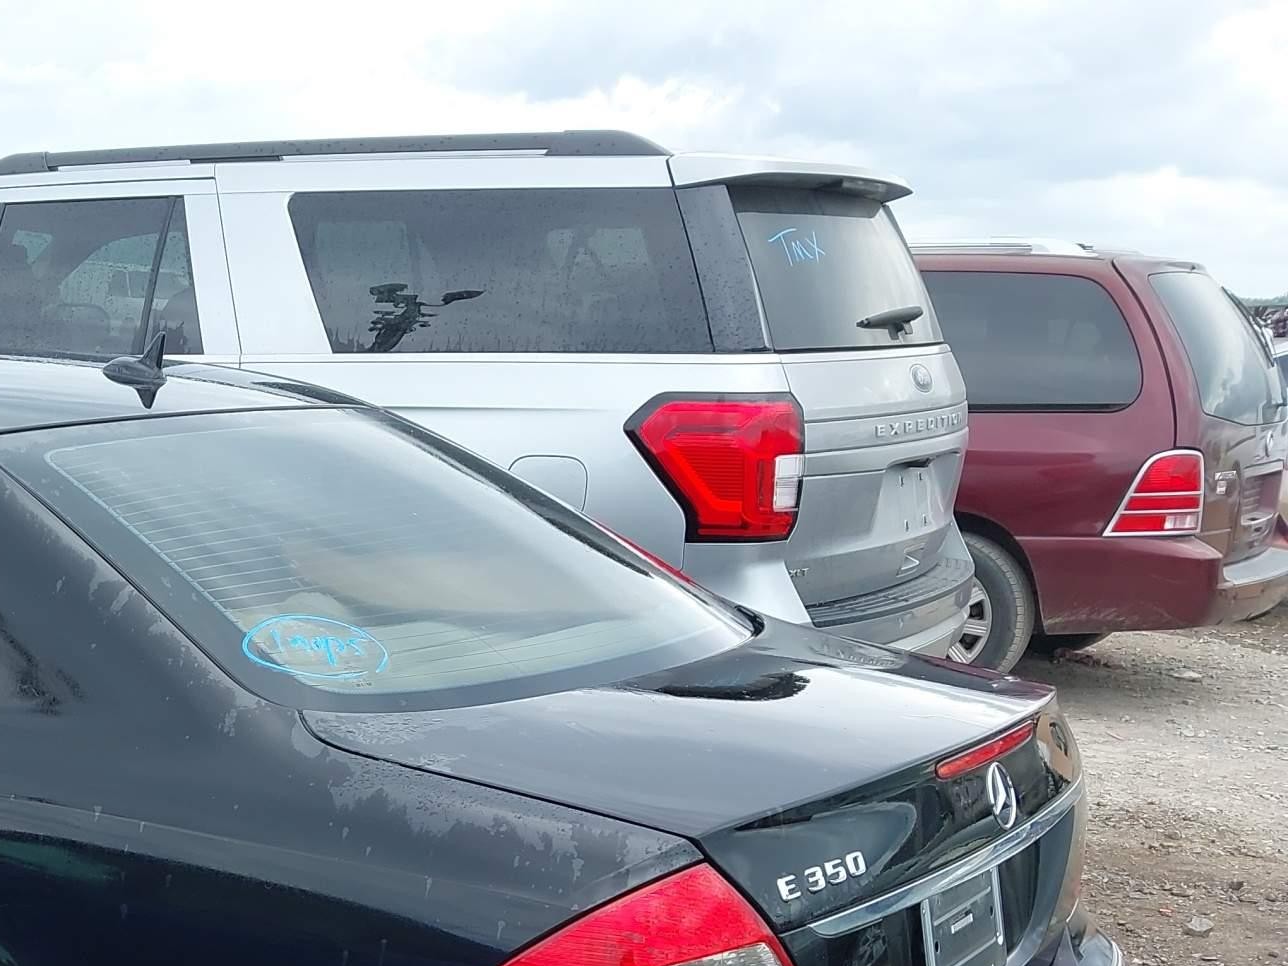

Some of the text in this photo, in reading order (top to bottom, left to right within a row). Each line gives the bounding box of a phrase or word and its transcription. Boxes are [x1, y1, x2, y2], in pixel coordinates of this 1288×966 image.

[875, 412, 961, 438] EXPEDITION
[776, 850, 867, 902] E 350
